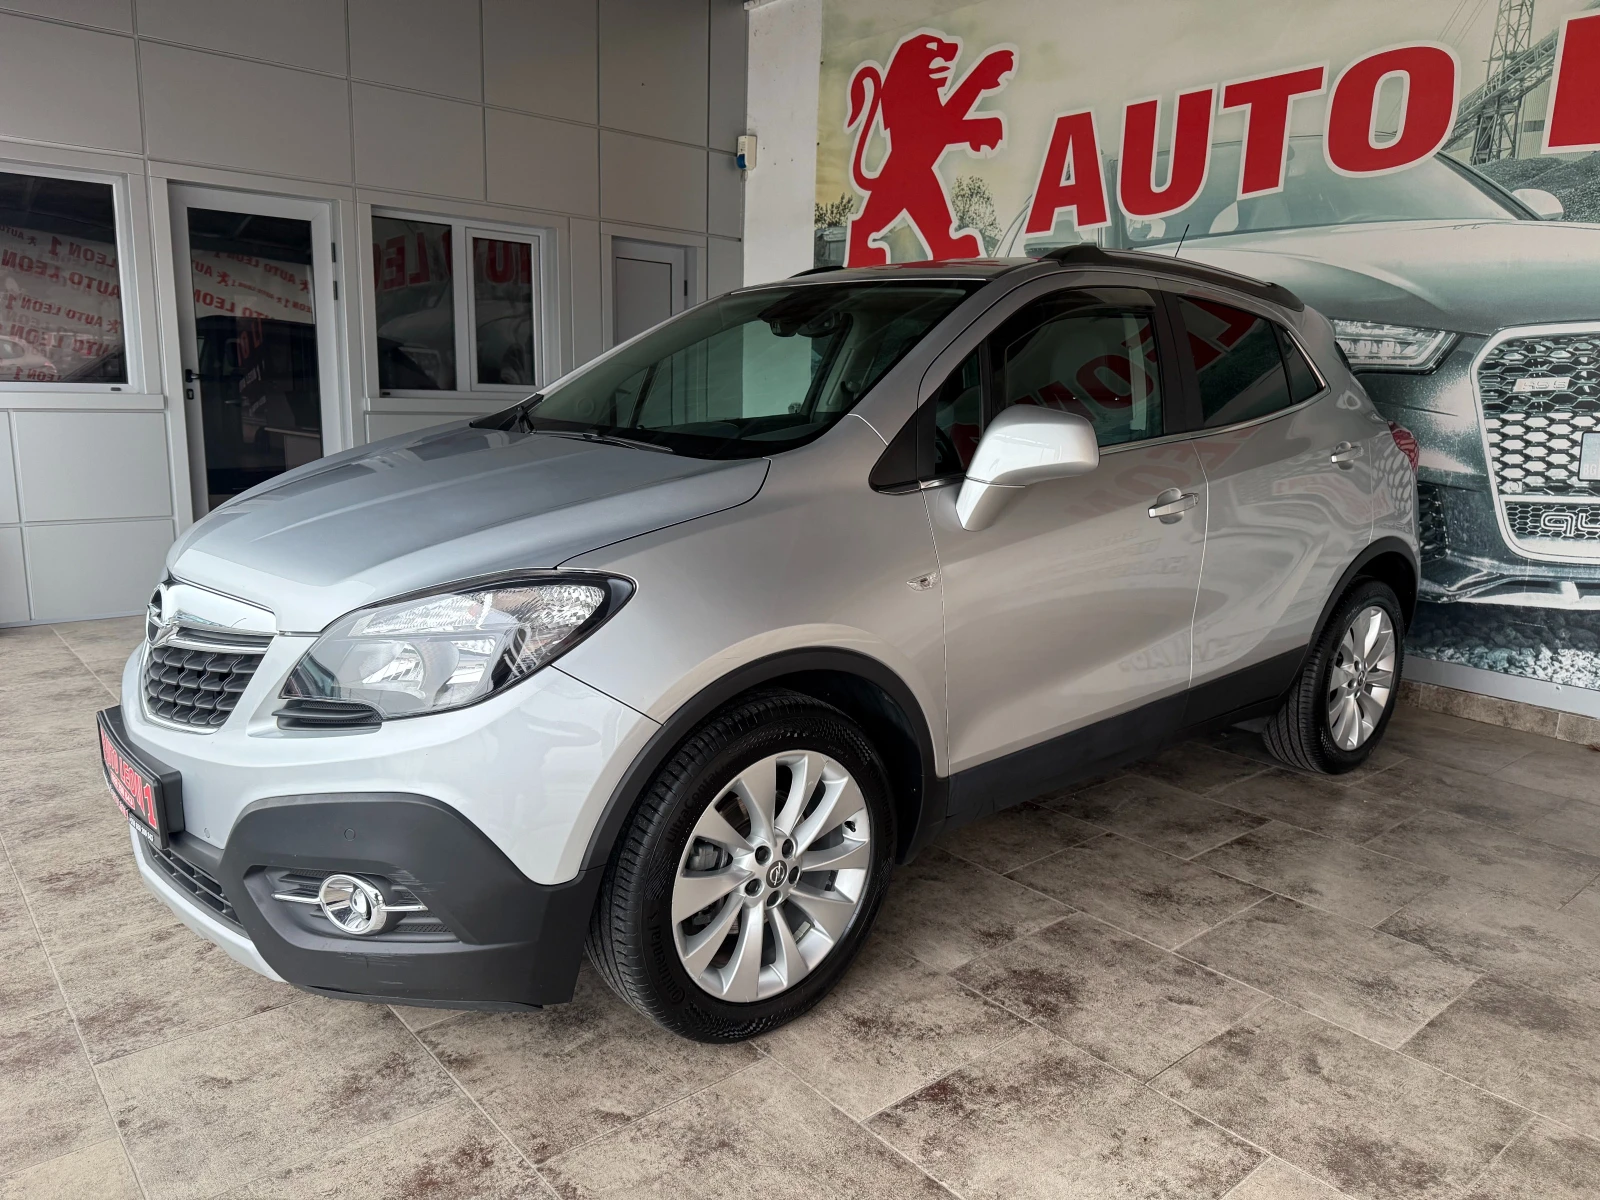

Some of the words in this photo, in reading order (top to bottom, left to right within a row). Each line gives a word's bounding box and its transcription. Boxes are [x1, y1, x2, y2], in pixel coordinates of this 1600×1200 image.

[1025, 44, 1459, 236] AUTO
[119, 756, 146, 817] LEON
[143, 782, 157, 830] 1
